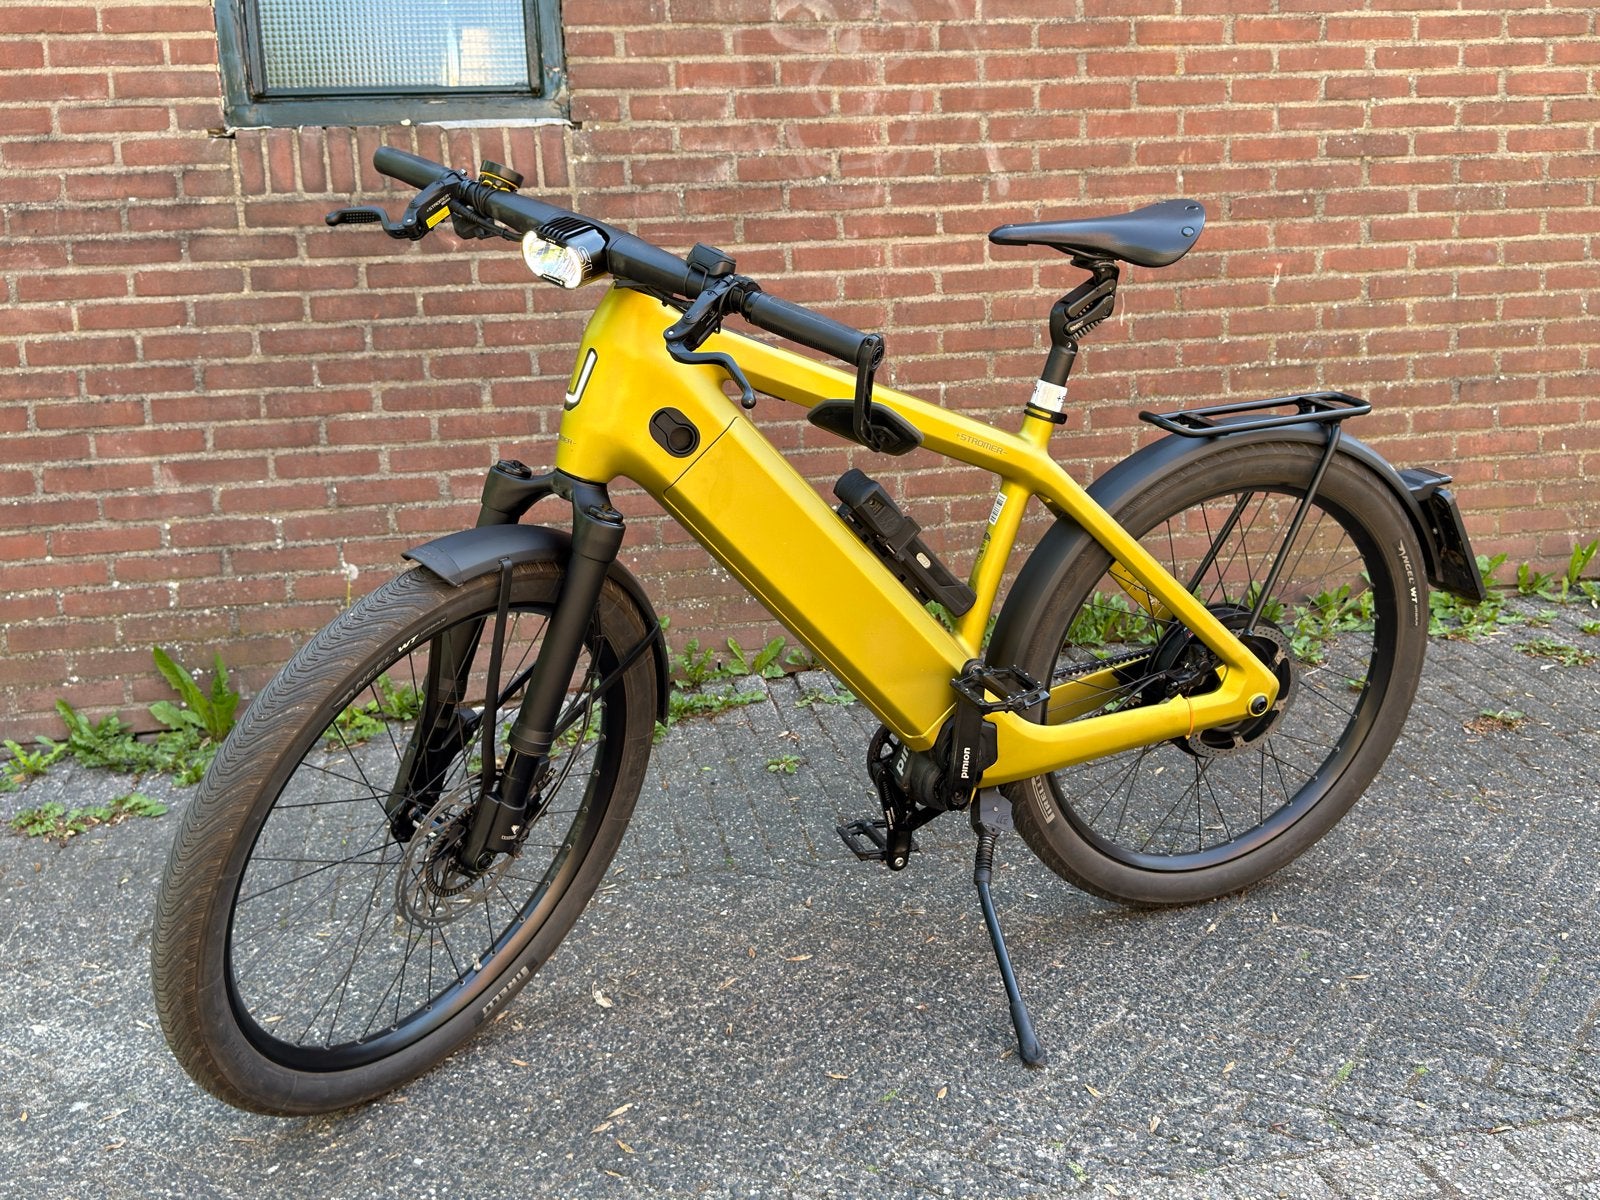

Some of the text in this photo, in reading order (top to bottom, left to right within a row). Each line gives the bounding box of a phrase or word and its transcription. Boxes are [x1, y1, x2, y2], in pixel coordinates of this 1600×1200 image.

[1398, 540, 1415, 585] ANGEL
[1410, 586, 1418, 604] WT
[398, 633, 420, 652] WT
[961, 747, 971, 779] pinion
